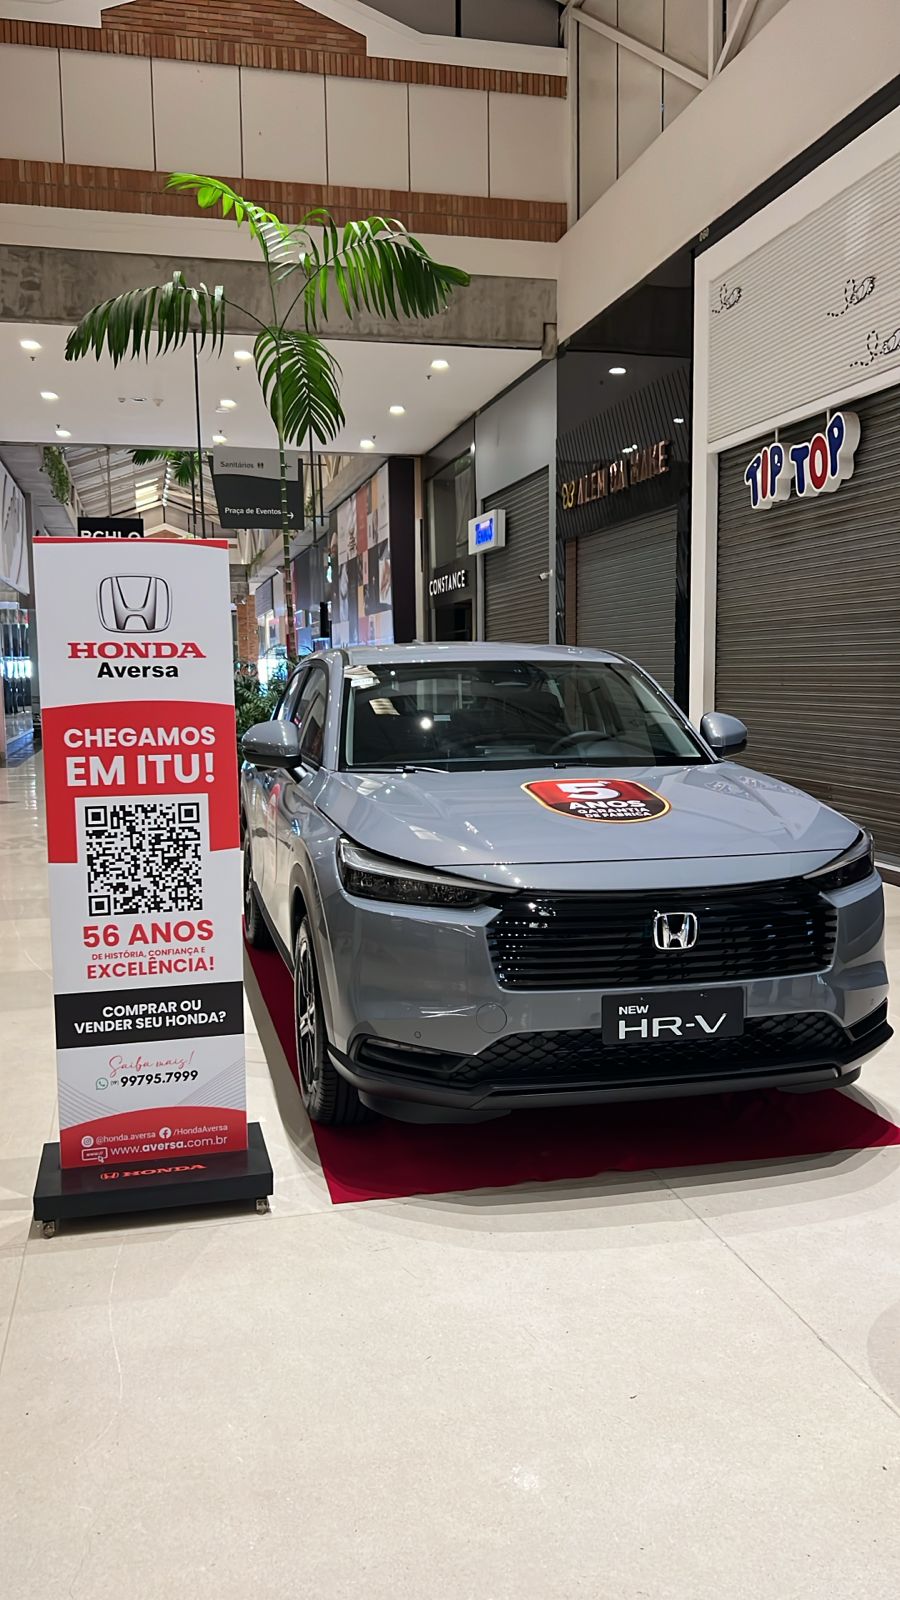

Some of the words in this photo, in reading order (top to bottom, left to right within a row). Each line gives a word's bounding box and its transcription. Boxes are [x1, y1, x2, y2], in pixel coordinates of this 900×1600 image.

[220, 461, 254, 469] Sanitários
[744, 443, 784, 509] TIP
[790, 412, 845, 497] TOP
[224, 507, 244, 516] Praça
[256, 507, 282, 515] Eventos
[429, 569, 465, 596] CONSTANCE
[68, 642, 206, 659] HONDA
[97, 662, 179, 678] Aversa
[63, 726, 216, 748] CHEGAMOS
[65, 755, 126, 787] EM
[137, 752, 215, 785] ITU!
[570, 800, 646, 810] ANOS
[83, 924, 120, 947] 56
[128, 919, 214, 945] ANOS
[92, 953, 103, 961] DE
[104, 949, 147, 960] HISTÓRIA,
[148, 947, 199, 958] CONFIANÇA
[87, 957, 215, 979] EXCELÊNCIA!
[103, 1002, 177, 1018] COMPRAR
[180, 999, 202, 1012] OU
[618, 1004, 649, 1016] NEW
[74, 1016, 132, 1034] VENDER
[136, 1014, 163, 1029] SEU
[166, 1011, 227, 1027] HONDA?
[618, 1012, 728, 1040] HR-V
[108, 1055, 152, 1078] Saiba
[155, 1050, 195, 1070] mais!
[120, 1070, 198, 1087] 99795.7999
[96, 1132, 156, 1144] @honda.aversa
[173, 1124, 228, 1136] /HondaAversa
[110, 1136, 228, 1155] www.aversa.com.br
[123, 1164, 207, 1178] HONDA
